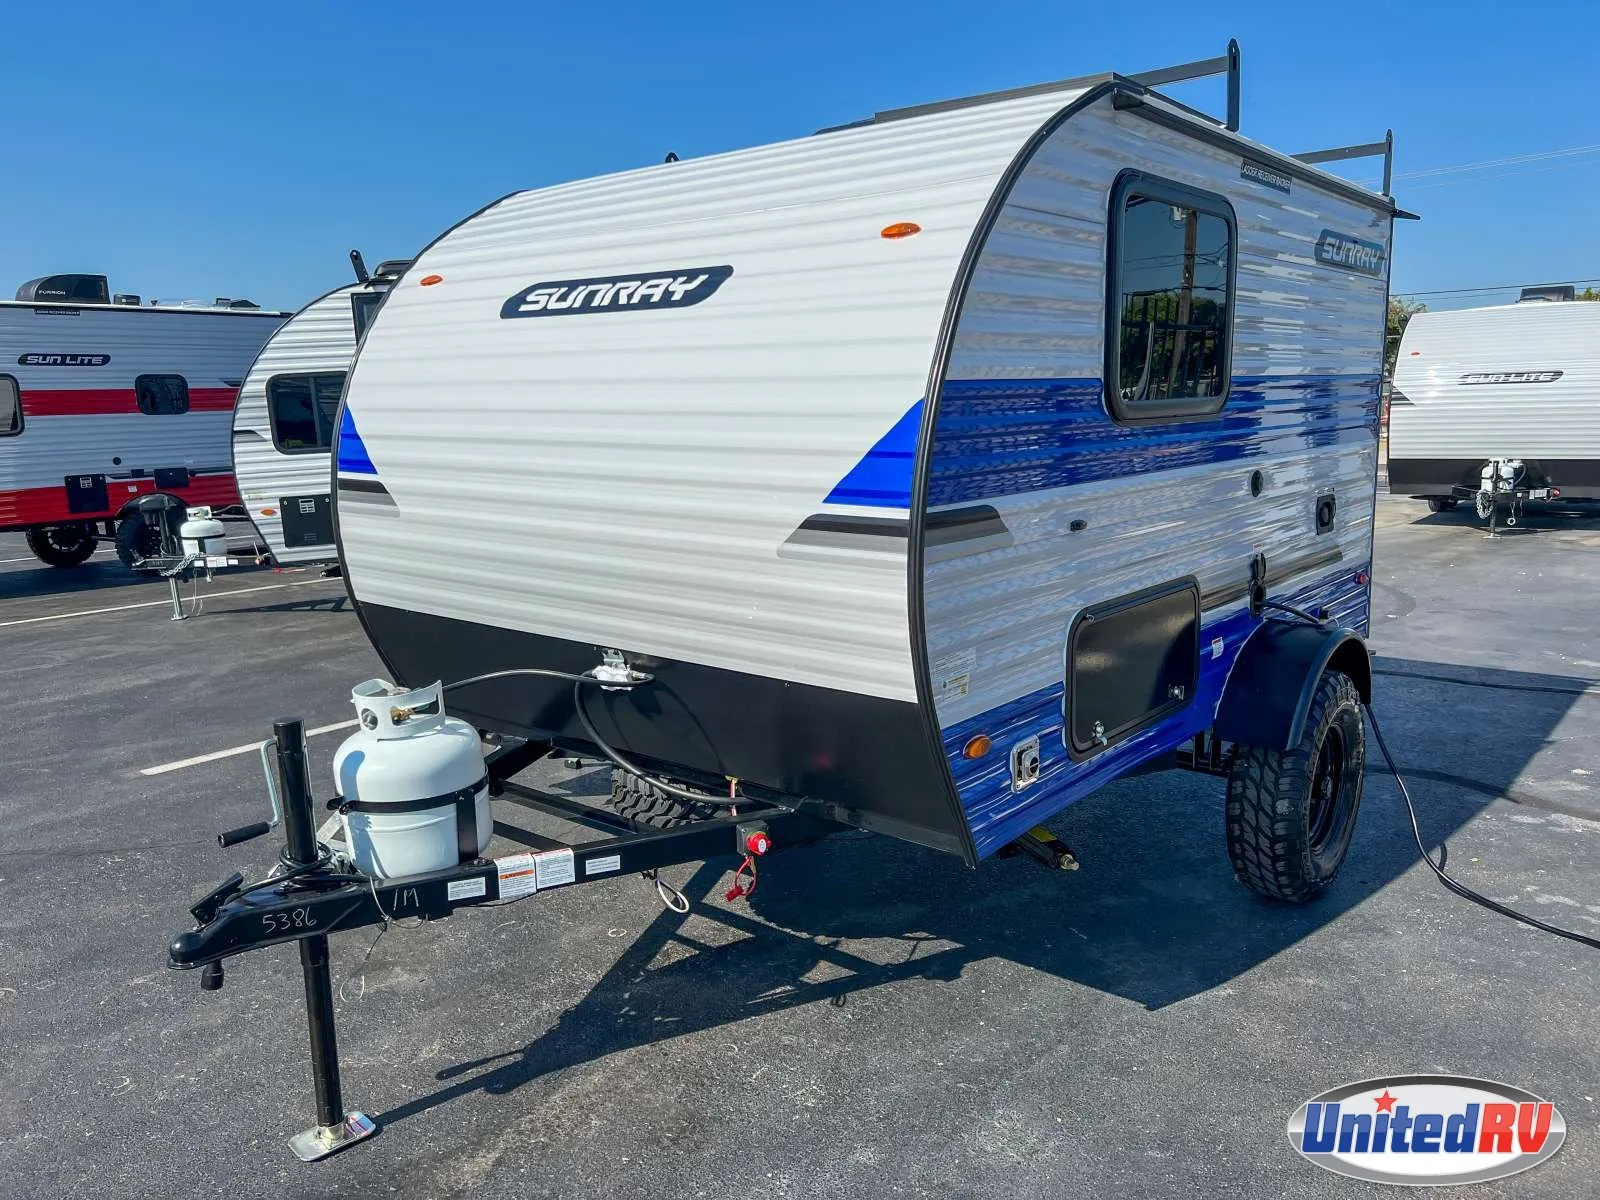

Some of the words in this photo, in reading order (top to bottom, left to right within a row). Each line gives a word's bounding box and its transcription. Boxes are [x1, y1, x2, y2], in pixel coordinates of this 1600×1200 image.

[1321, 236, 1380, 269] SUNRAY
[518, 274, 710, 313] SUNRAY
[26, 355, 62, 364] SUN
[65, 356, 104, 365] LITE
[261, 906, 318, 935] 5386
